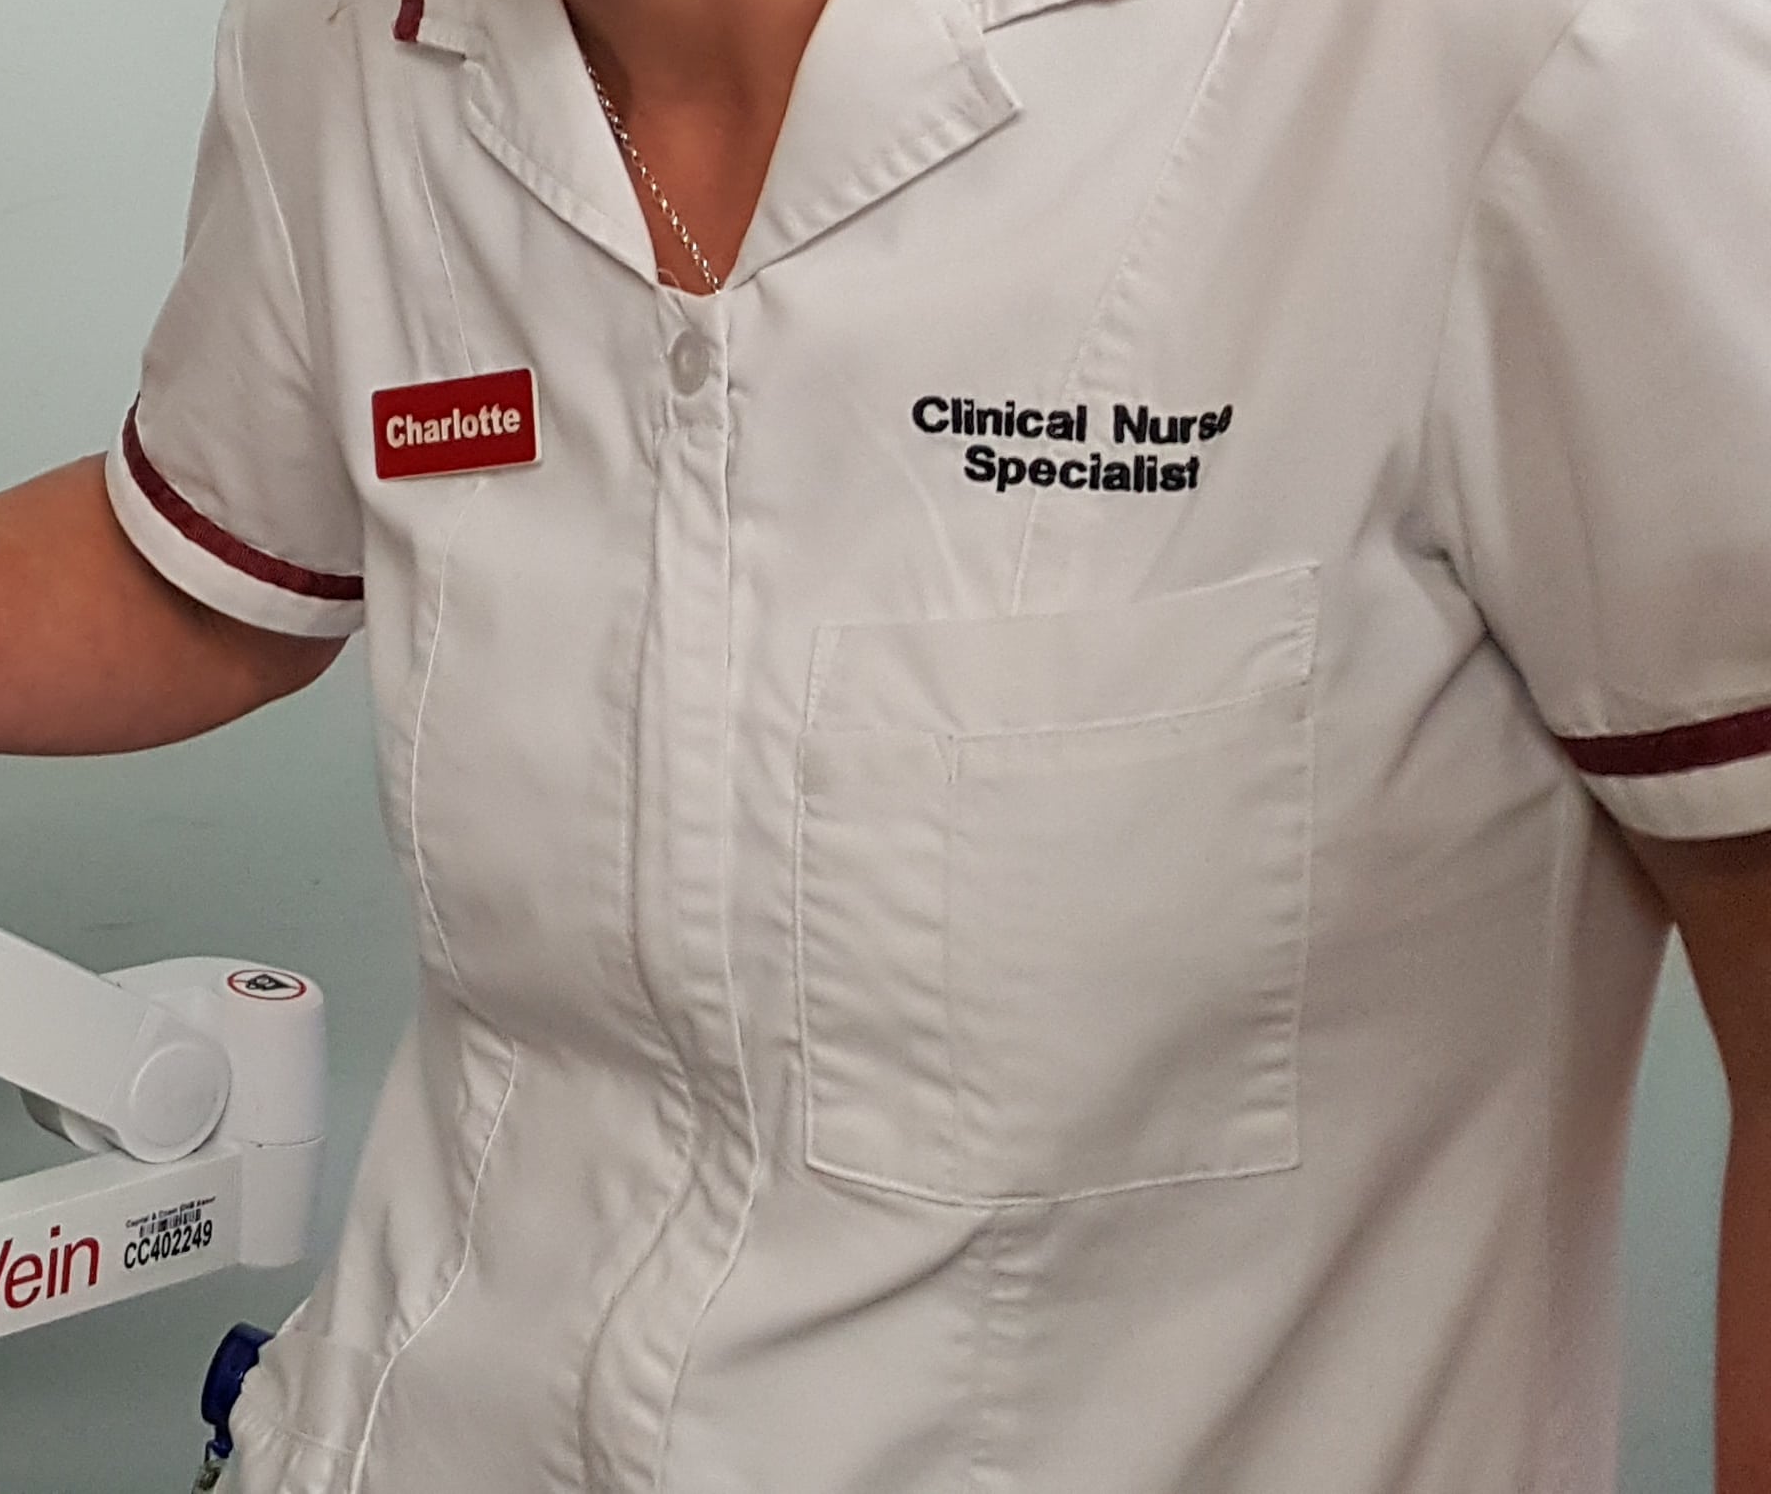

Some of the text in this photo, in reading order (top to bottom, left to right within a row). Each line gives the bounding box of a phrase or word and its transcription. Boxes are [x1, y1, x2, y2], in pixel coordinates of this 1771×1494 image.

[385, 402, 522, 449] Charlotte
[911, 395, 1088, 443] Clinical
[963, 444, 1201, 493] Specialist
[123, 1219, 213, 1269] CC402249
